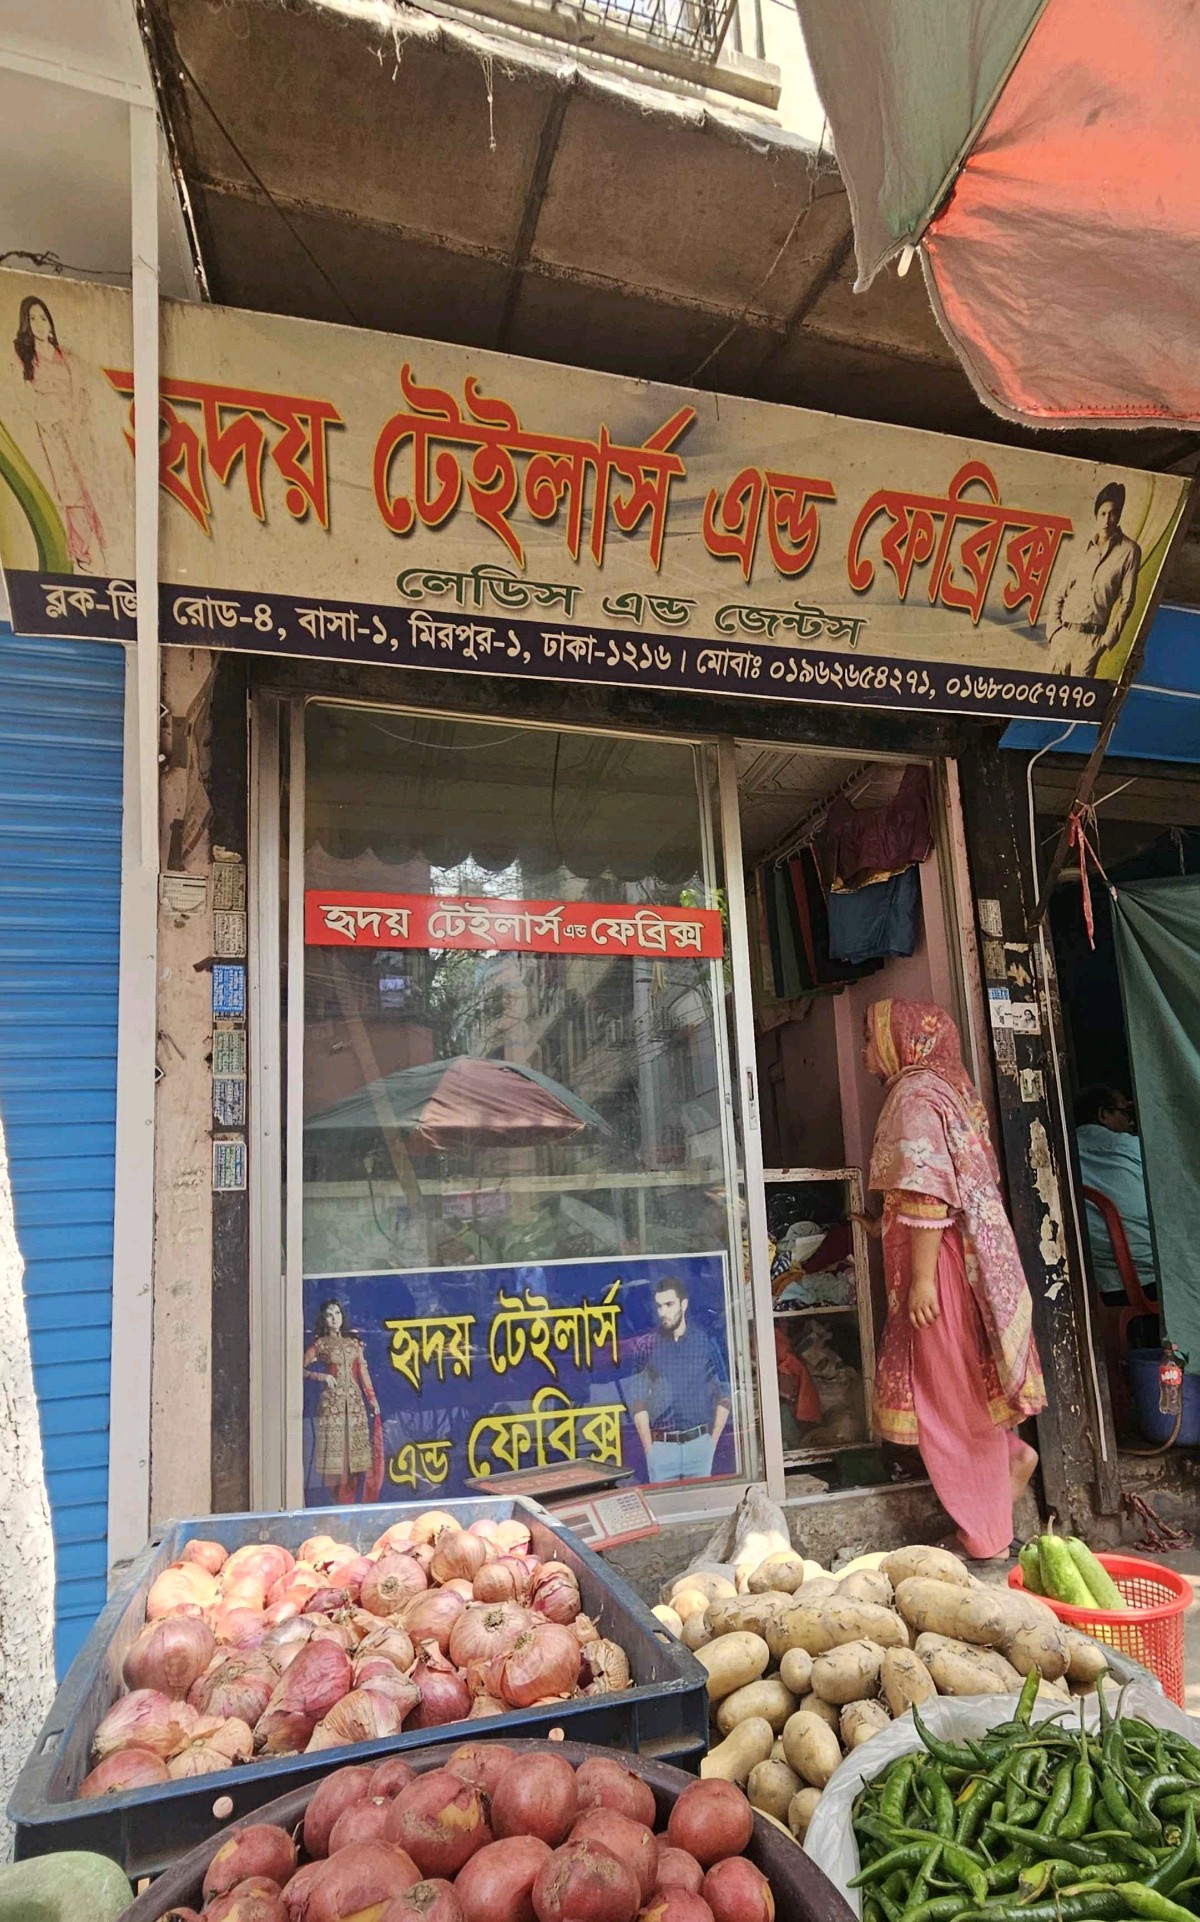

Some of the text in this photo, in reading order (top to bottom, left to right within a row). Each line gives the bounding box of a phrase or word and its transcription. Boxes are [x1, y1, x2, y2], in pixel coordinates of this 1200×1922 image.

[373, 363, 697, 572] টেইলার্স
[703, 467, 836, 582] এন্ড
[847, 460, 1075, 625] ফেব্রিক্স
[396, 563, 869, 649] লেডিস এন্ড জেন্টস
[320, 902, 704, 952] হৃদয় টেইলার্স এন্ড ফেব্রিক্স
[385, 1279, 623, 1391] হৃদয় টেইলার্স
[388, 1441, 452, 1489] এন্ড
